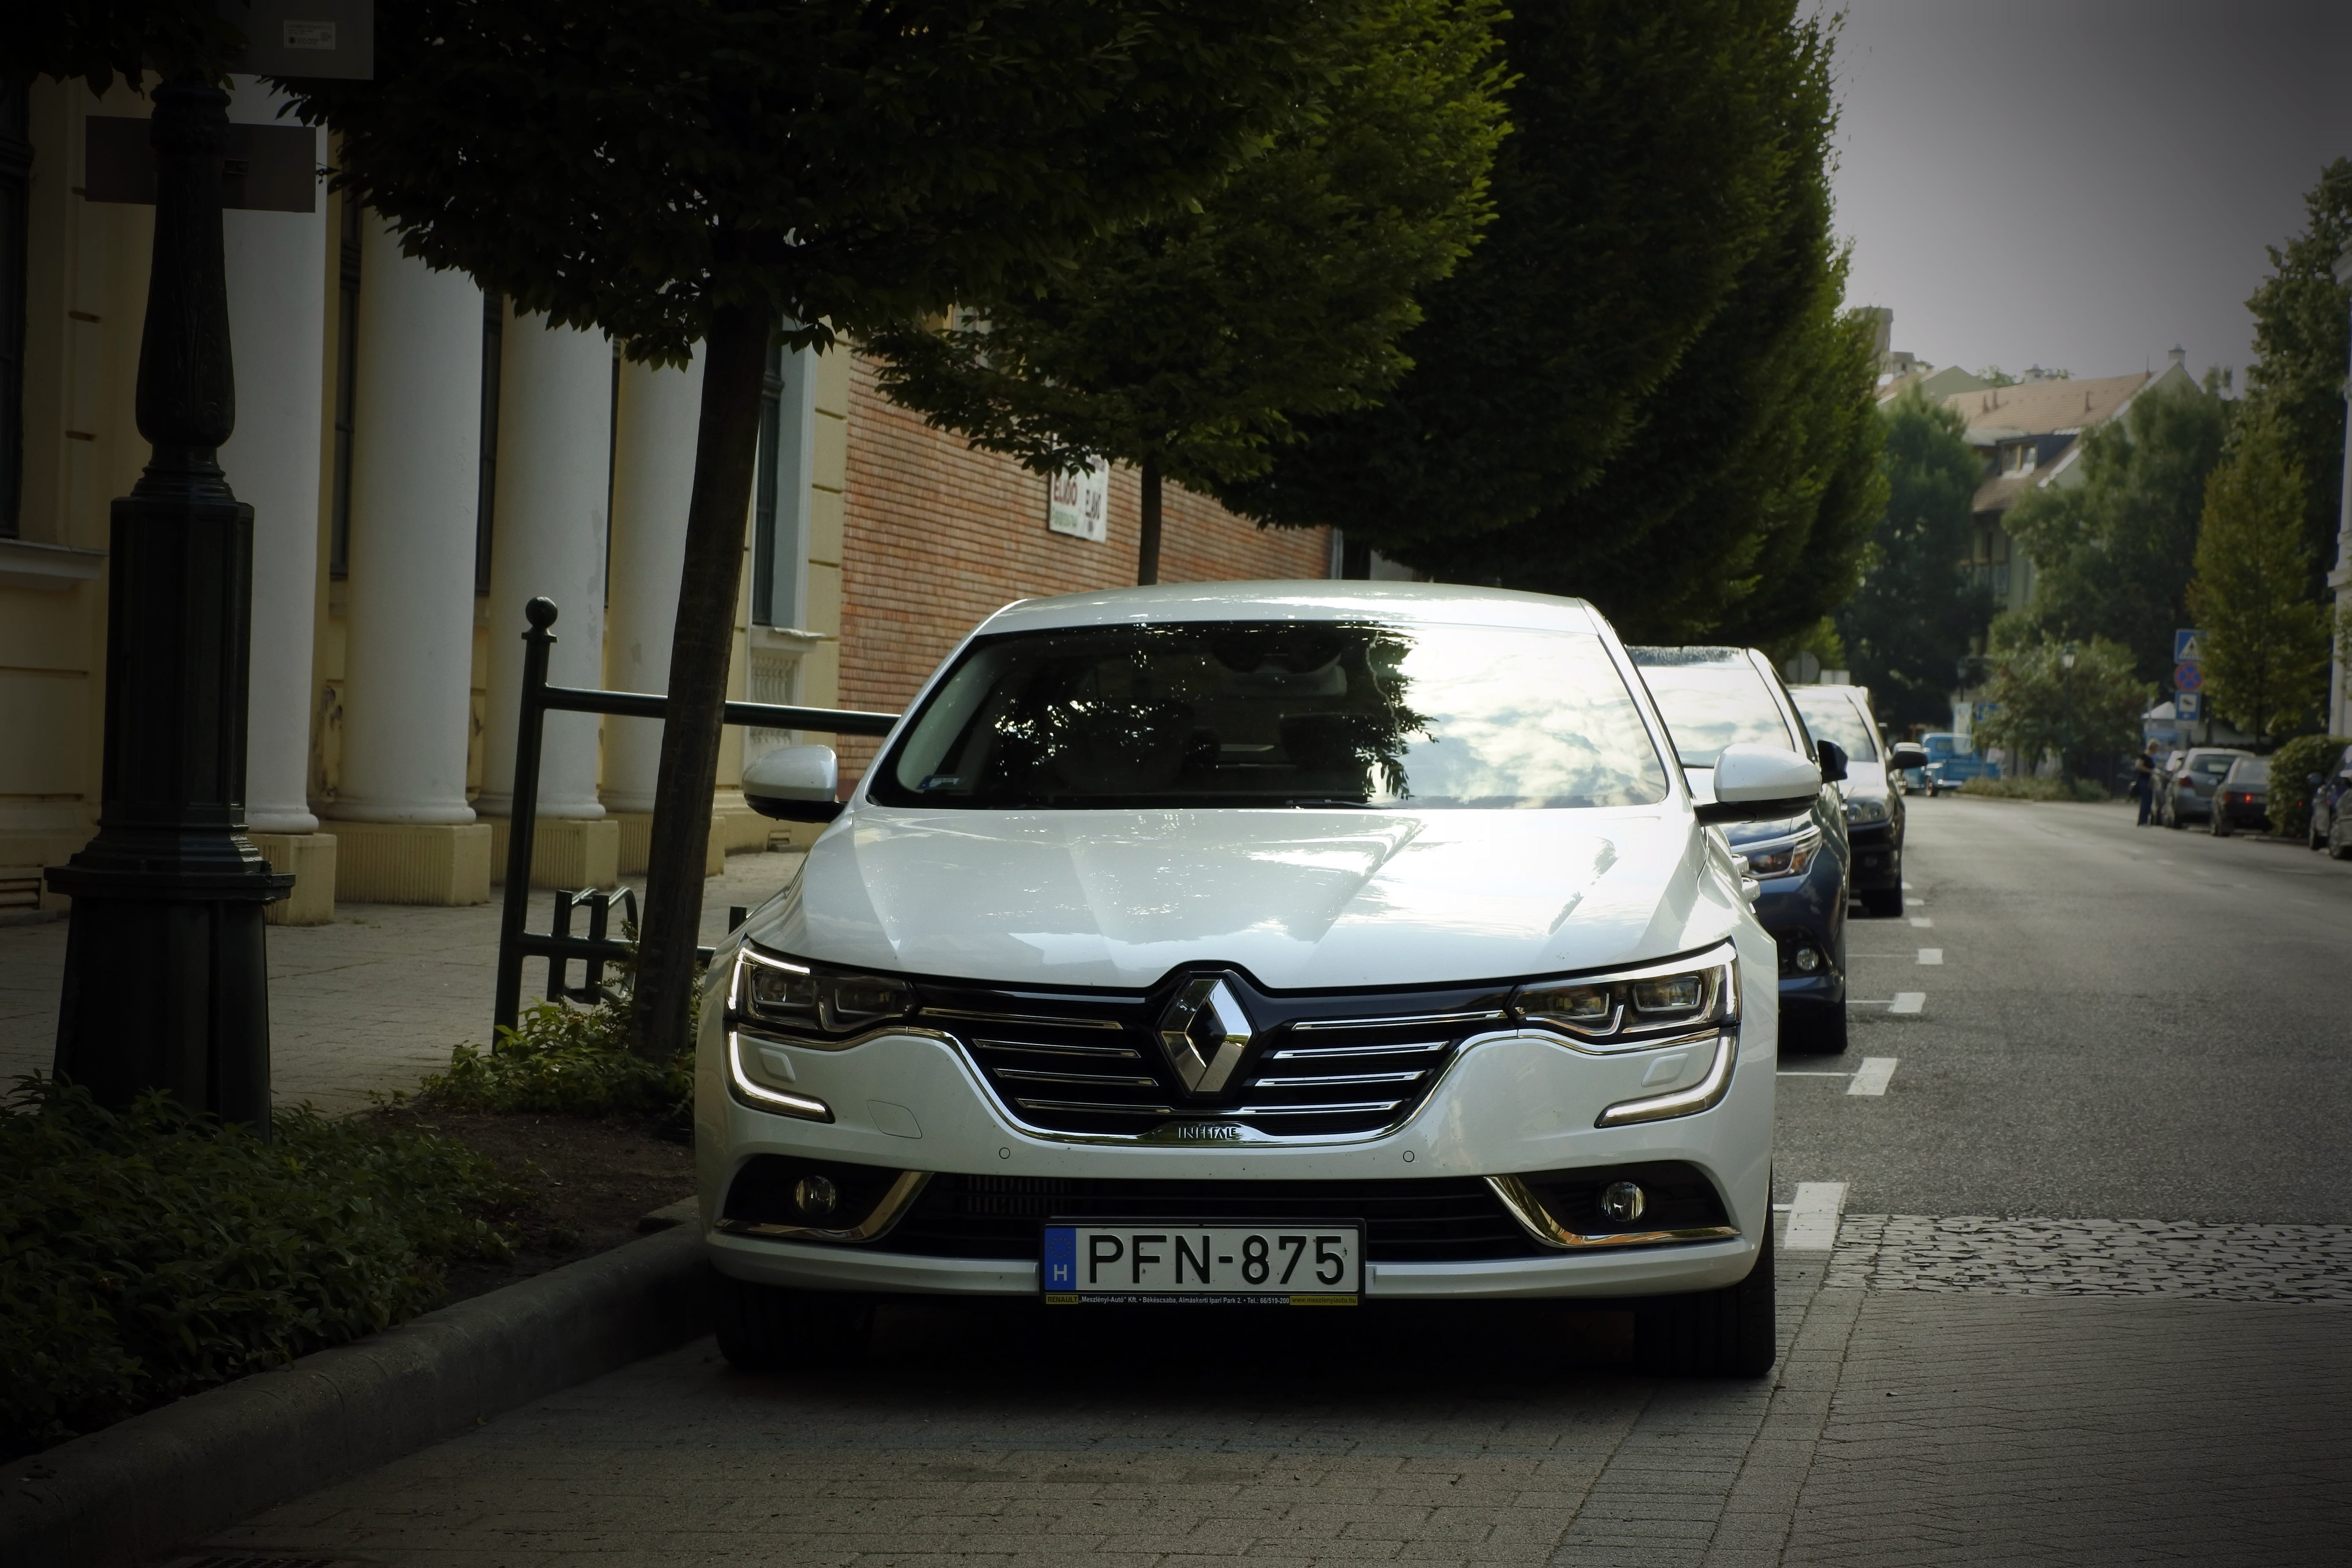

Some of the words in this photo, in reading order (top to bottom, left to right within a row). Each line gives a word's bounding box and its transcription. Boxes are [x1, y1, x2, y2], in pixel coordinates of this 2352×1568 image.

[1090, 1235, 1344, 1285] PFN-875
[1054, 1264, 1067, 1281] H
[1209, 1297, 1222, 1305] Ipari
